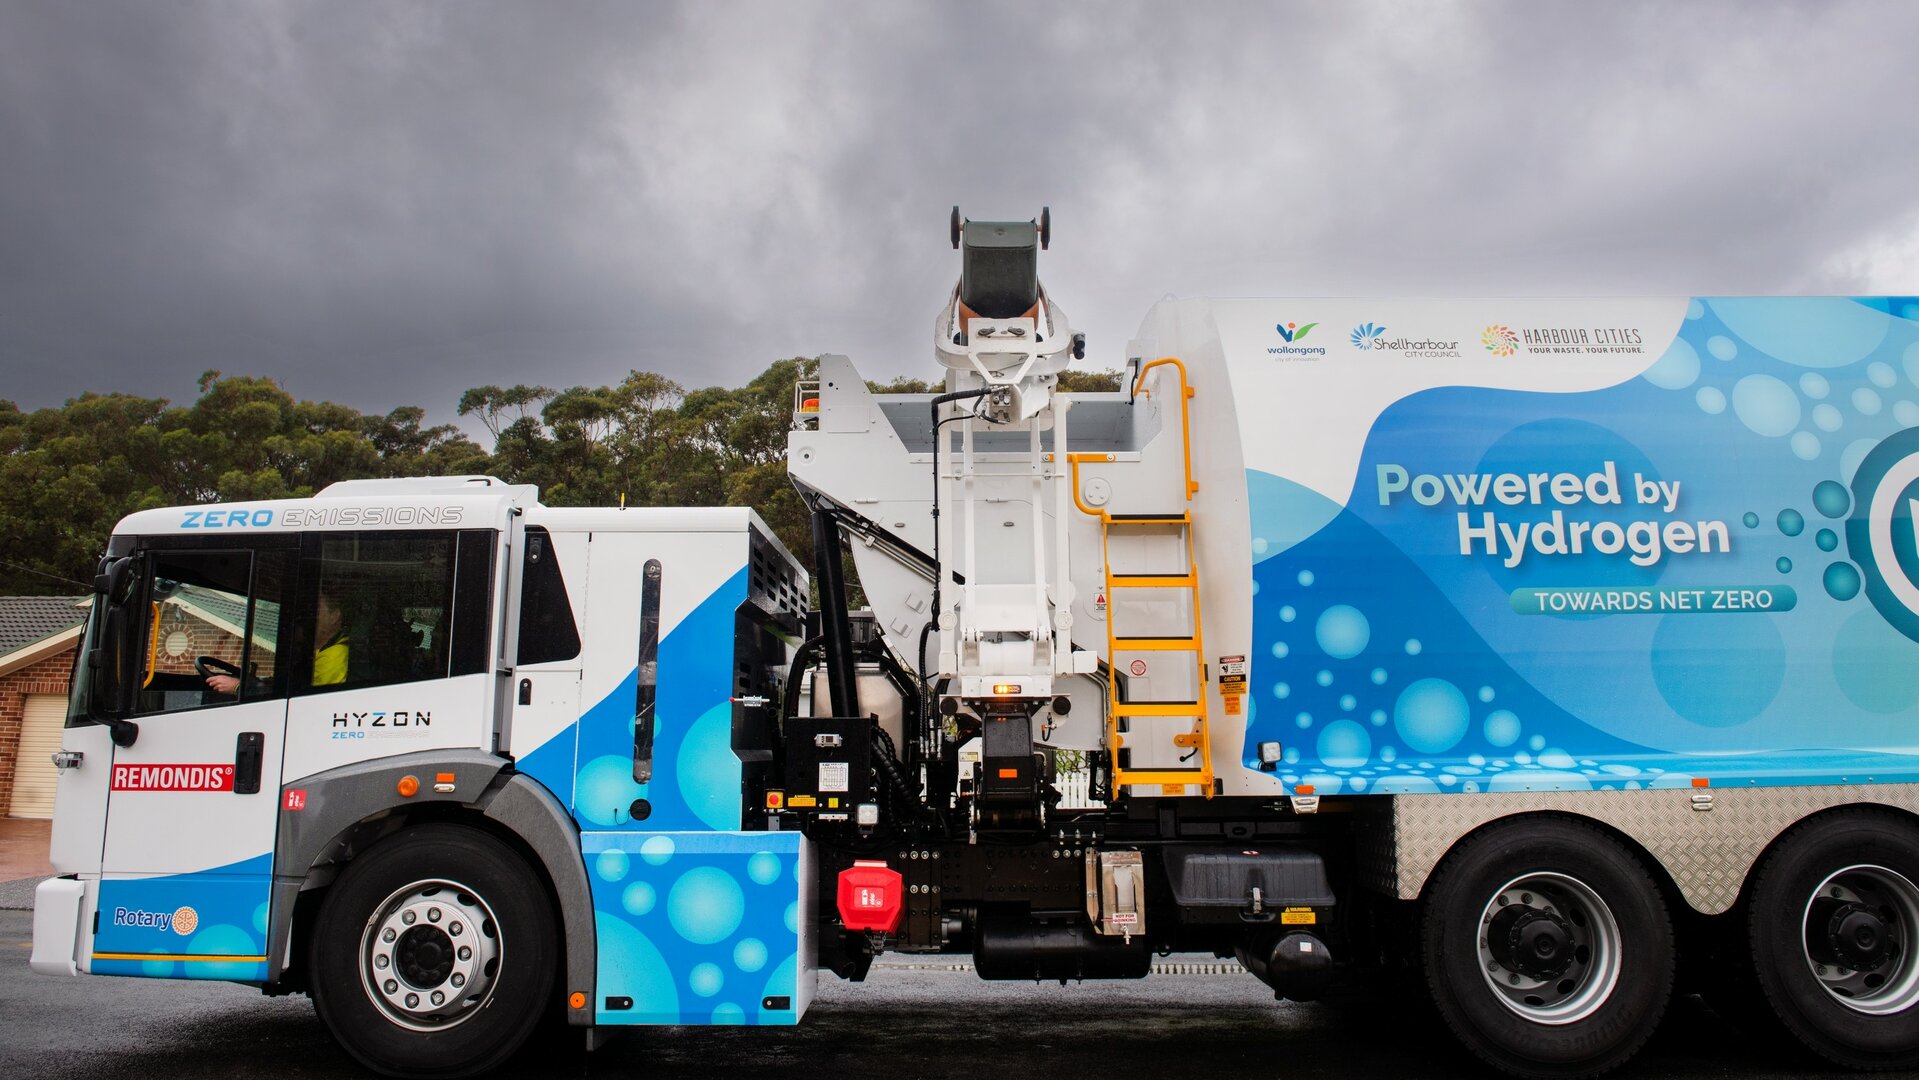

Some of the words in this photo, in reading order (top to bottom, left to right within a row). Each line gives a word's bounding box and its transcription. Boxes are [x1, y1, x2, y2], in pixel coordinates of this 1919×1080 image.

[1374, 338, 1459, 350] Shellharbour
[1523, 328, 1589, 344] HARBOUR
[1594, 328, 1642, 344] CITIES
[1267, 346, 1326, 356] wollongong
[1376, 461, 1622, 506] Powered
[1634, 473, 1681, 513] by
[180, 509, 274, 528] ZERO
[281, 506, 464, 527] EMISSIONS
[1457, 510, 1731, 568] Hydrogen
[1534, 591, 1653, 611] TOWARDS
[1659, 591, 1706, 610] NET
[1711, 589, 1773, 609] ZERO
[333, 711, 431, 727] HYZON
[332, 731, 365, 739] ZERO
[115, 907, 172, 930] Rotary
